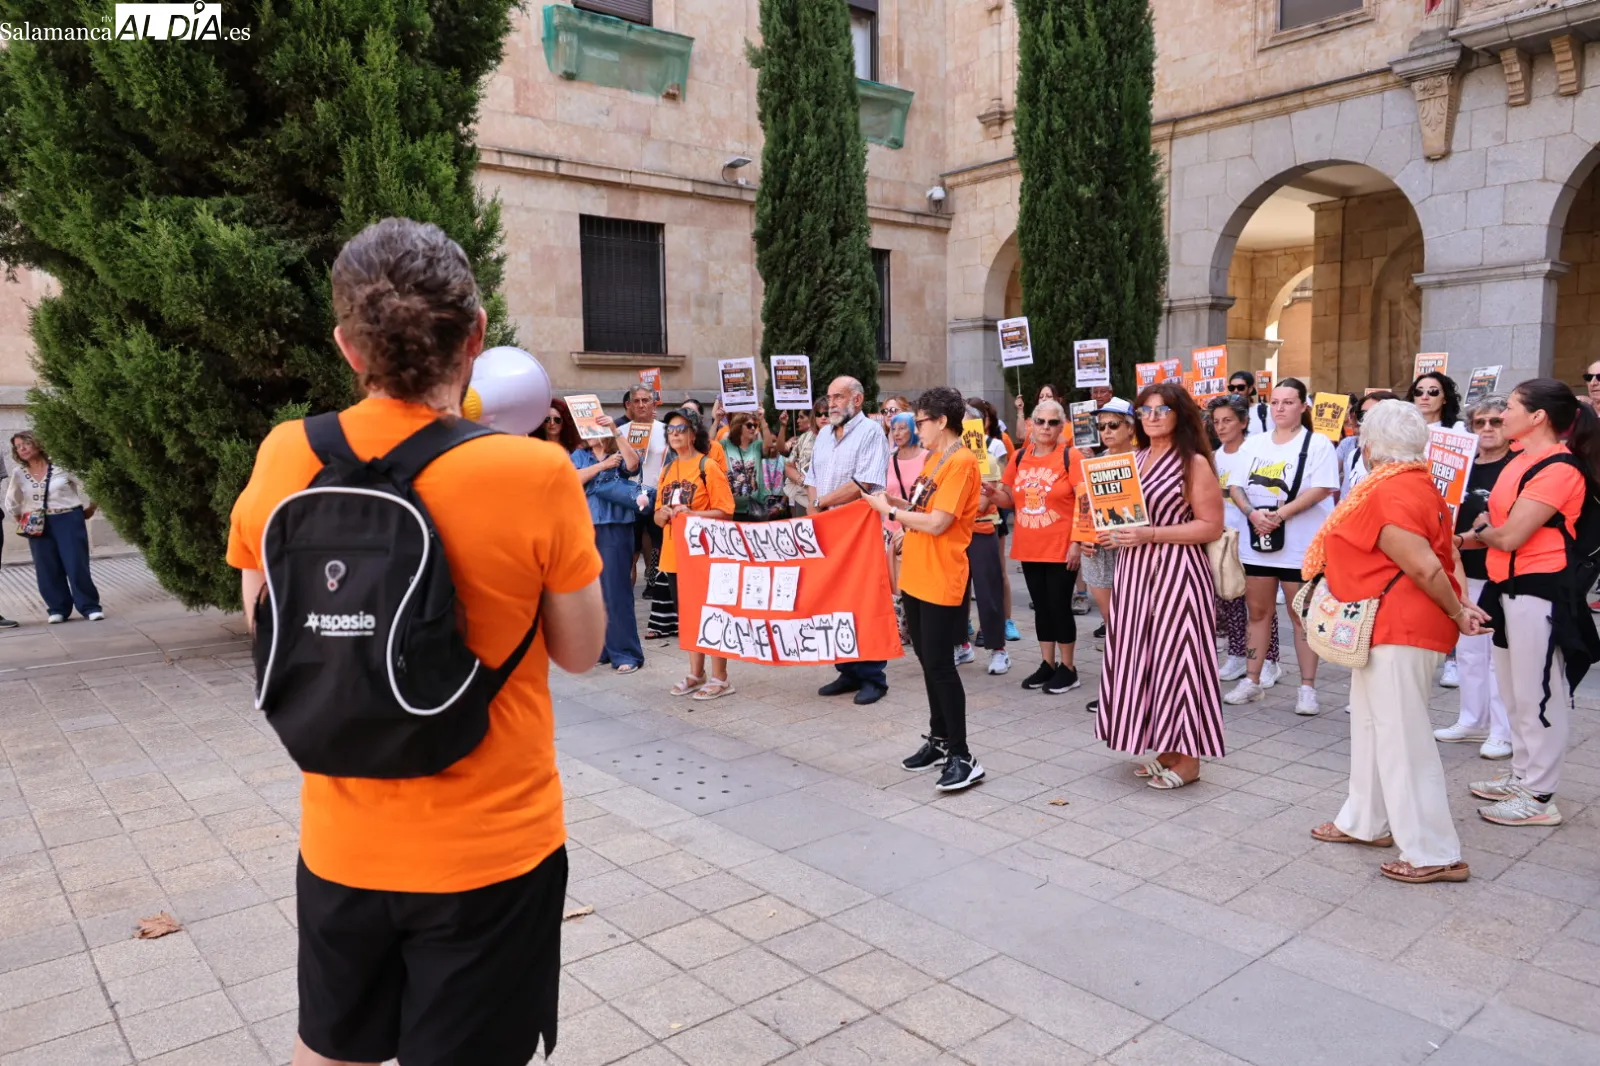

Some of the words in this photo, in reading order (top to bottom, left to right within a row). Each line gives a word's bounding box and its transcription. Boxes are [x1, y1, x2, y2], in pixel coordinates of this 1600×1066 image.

[1202, 368, 1215, 377] LEY
[1446, 435, 1474, 451] GATOS
[1443, 452, 1465, 469] GATOS
[1090, 467, 1132, 484] CUMPLID
[1432, 462, 1456, 481] TIENEN
[1093, 484, 1105, 496] LA
[1106, 482, 1121, 495] LEY
